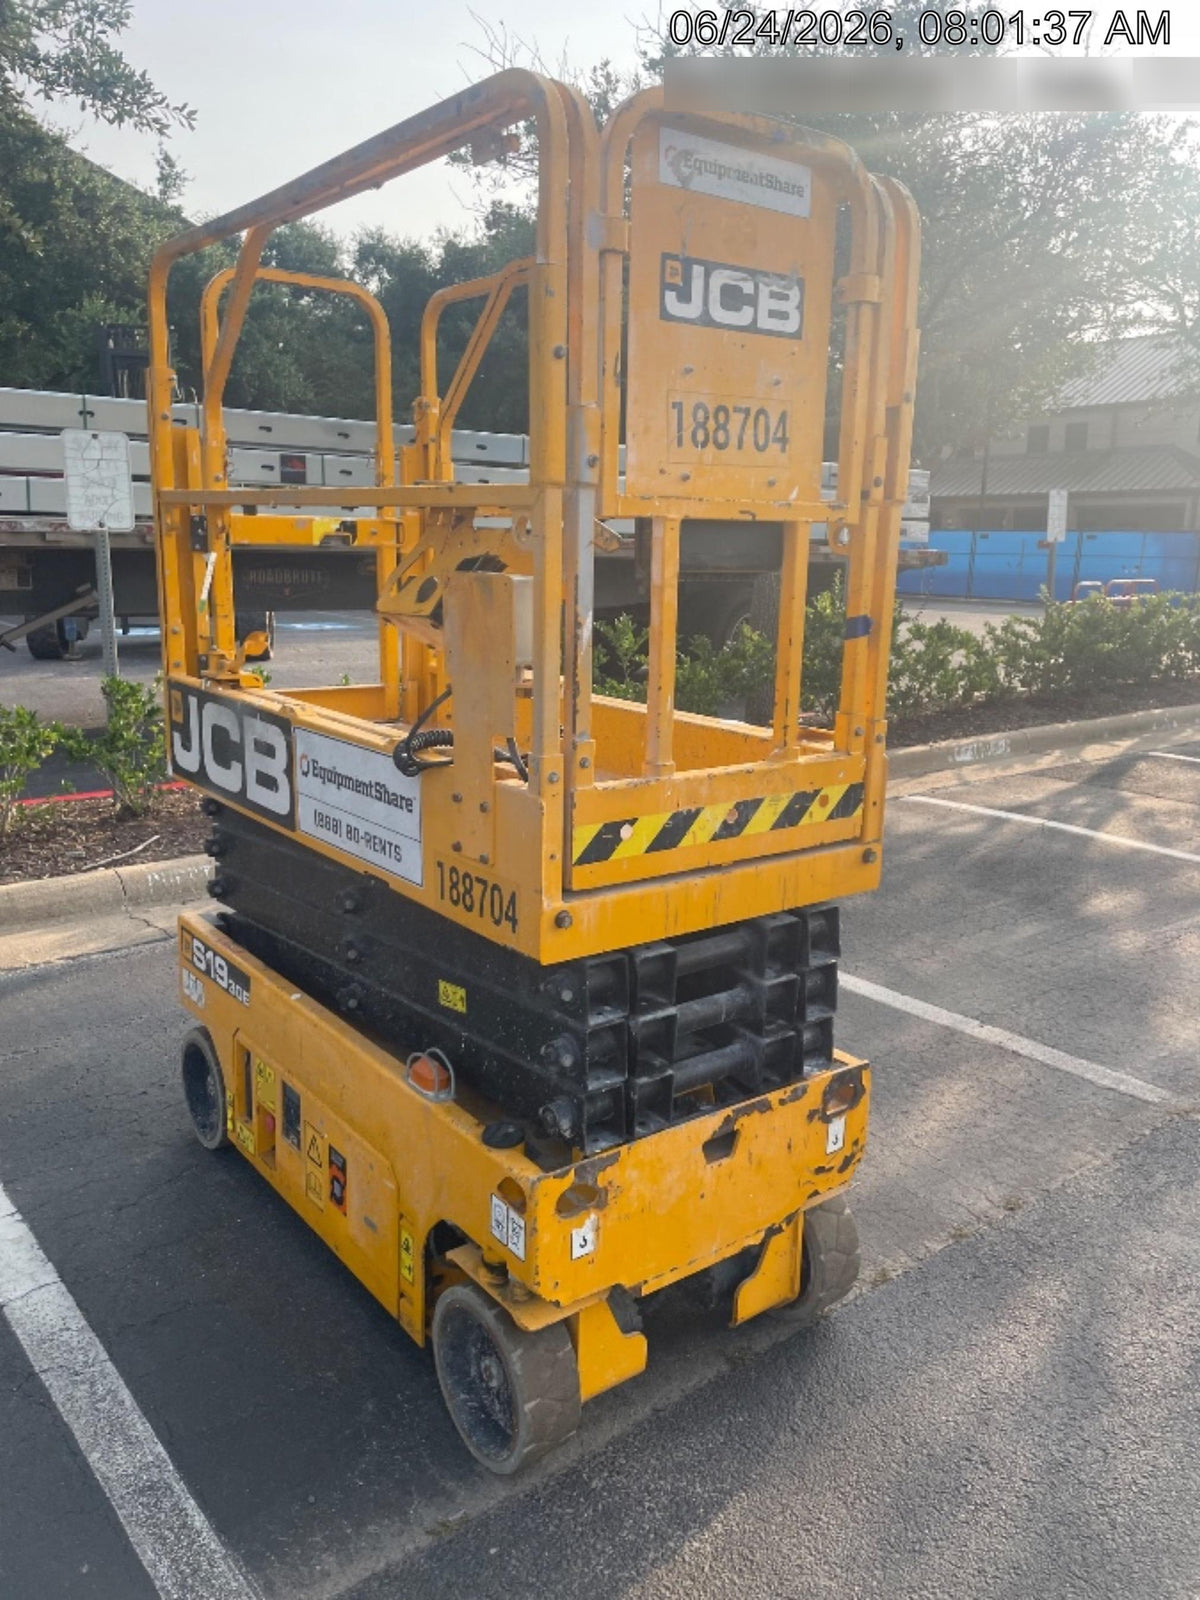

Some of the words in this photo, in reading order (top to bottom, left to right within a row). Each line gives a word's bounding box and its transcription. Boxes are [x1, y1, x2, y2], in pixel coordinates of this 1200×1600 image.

[682, 151, 805, 198] EquipmentShare
[664, 263, 801, 334] JCB
[671, 401, 790, 453] 188704
[172, 694, 291, 816] JCB
[311, 758, 414, 814] EquipmentShare
[313, 808, 342, 838] (888)
[437, 860, 518, 934] 188704
